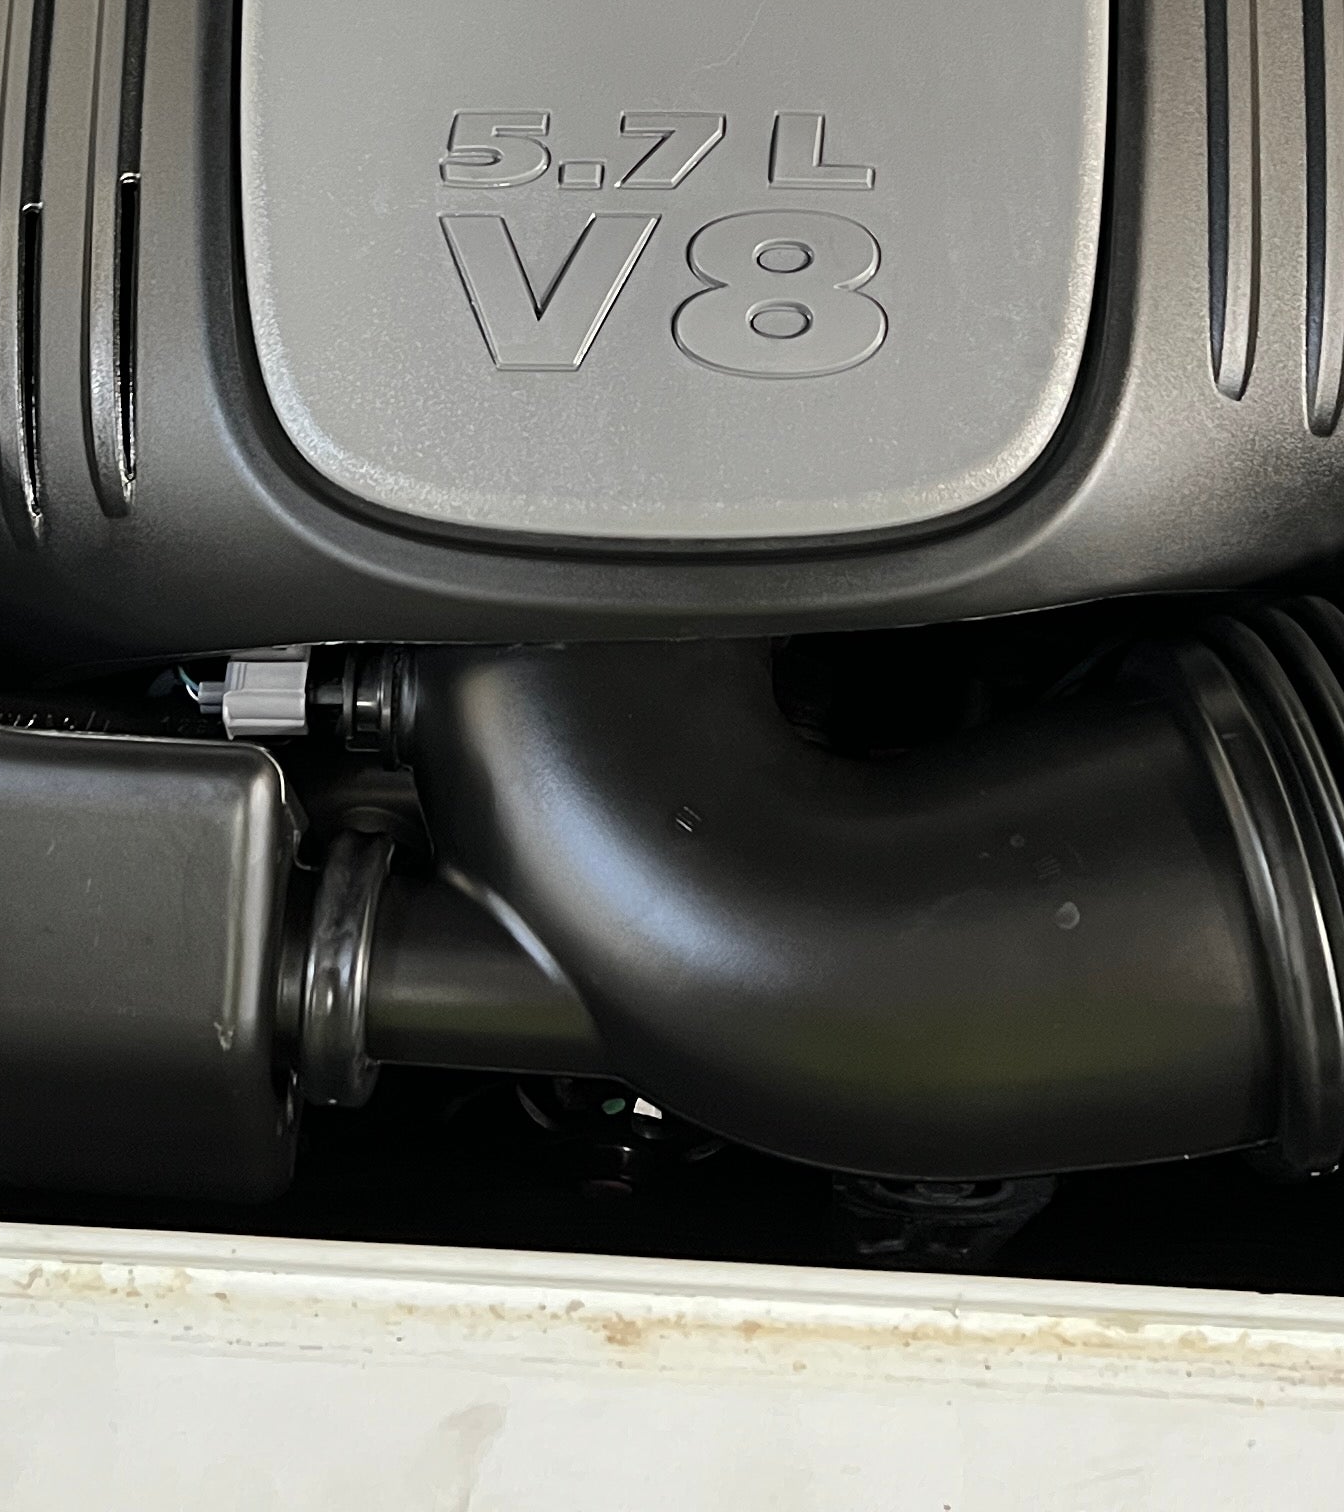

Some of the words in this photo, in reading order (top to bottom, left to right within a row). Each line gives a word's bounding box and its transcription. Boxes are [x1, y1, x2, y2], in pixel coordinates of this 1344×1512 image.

[439, 108, 726, 190] 5.7
[767, 108, 876, 190] L
[437, 208, 890, 381] V8
